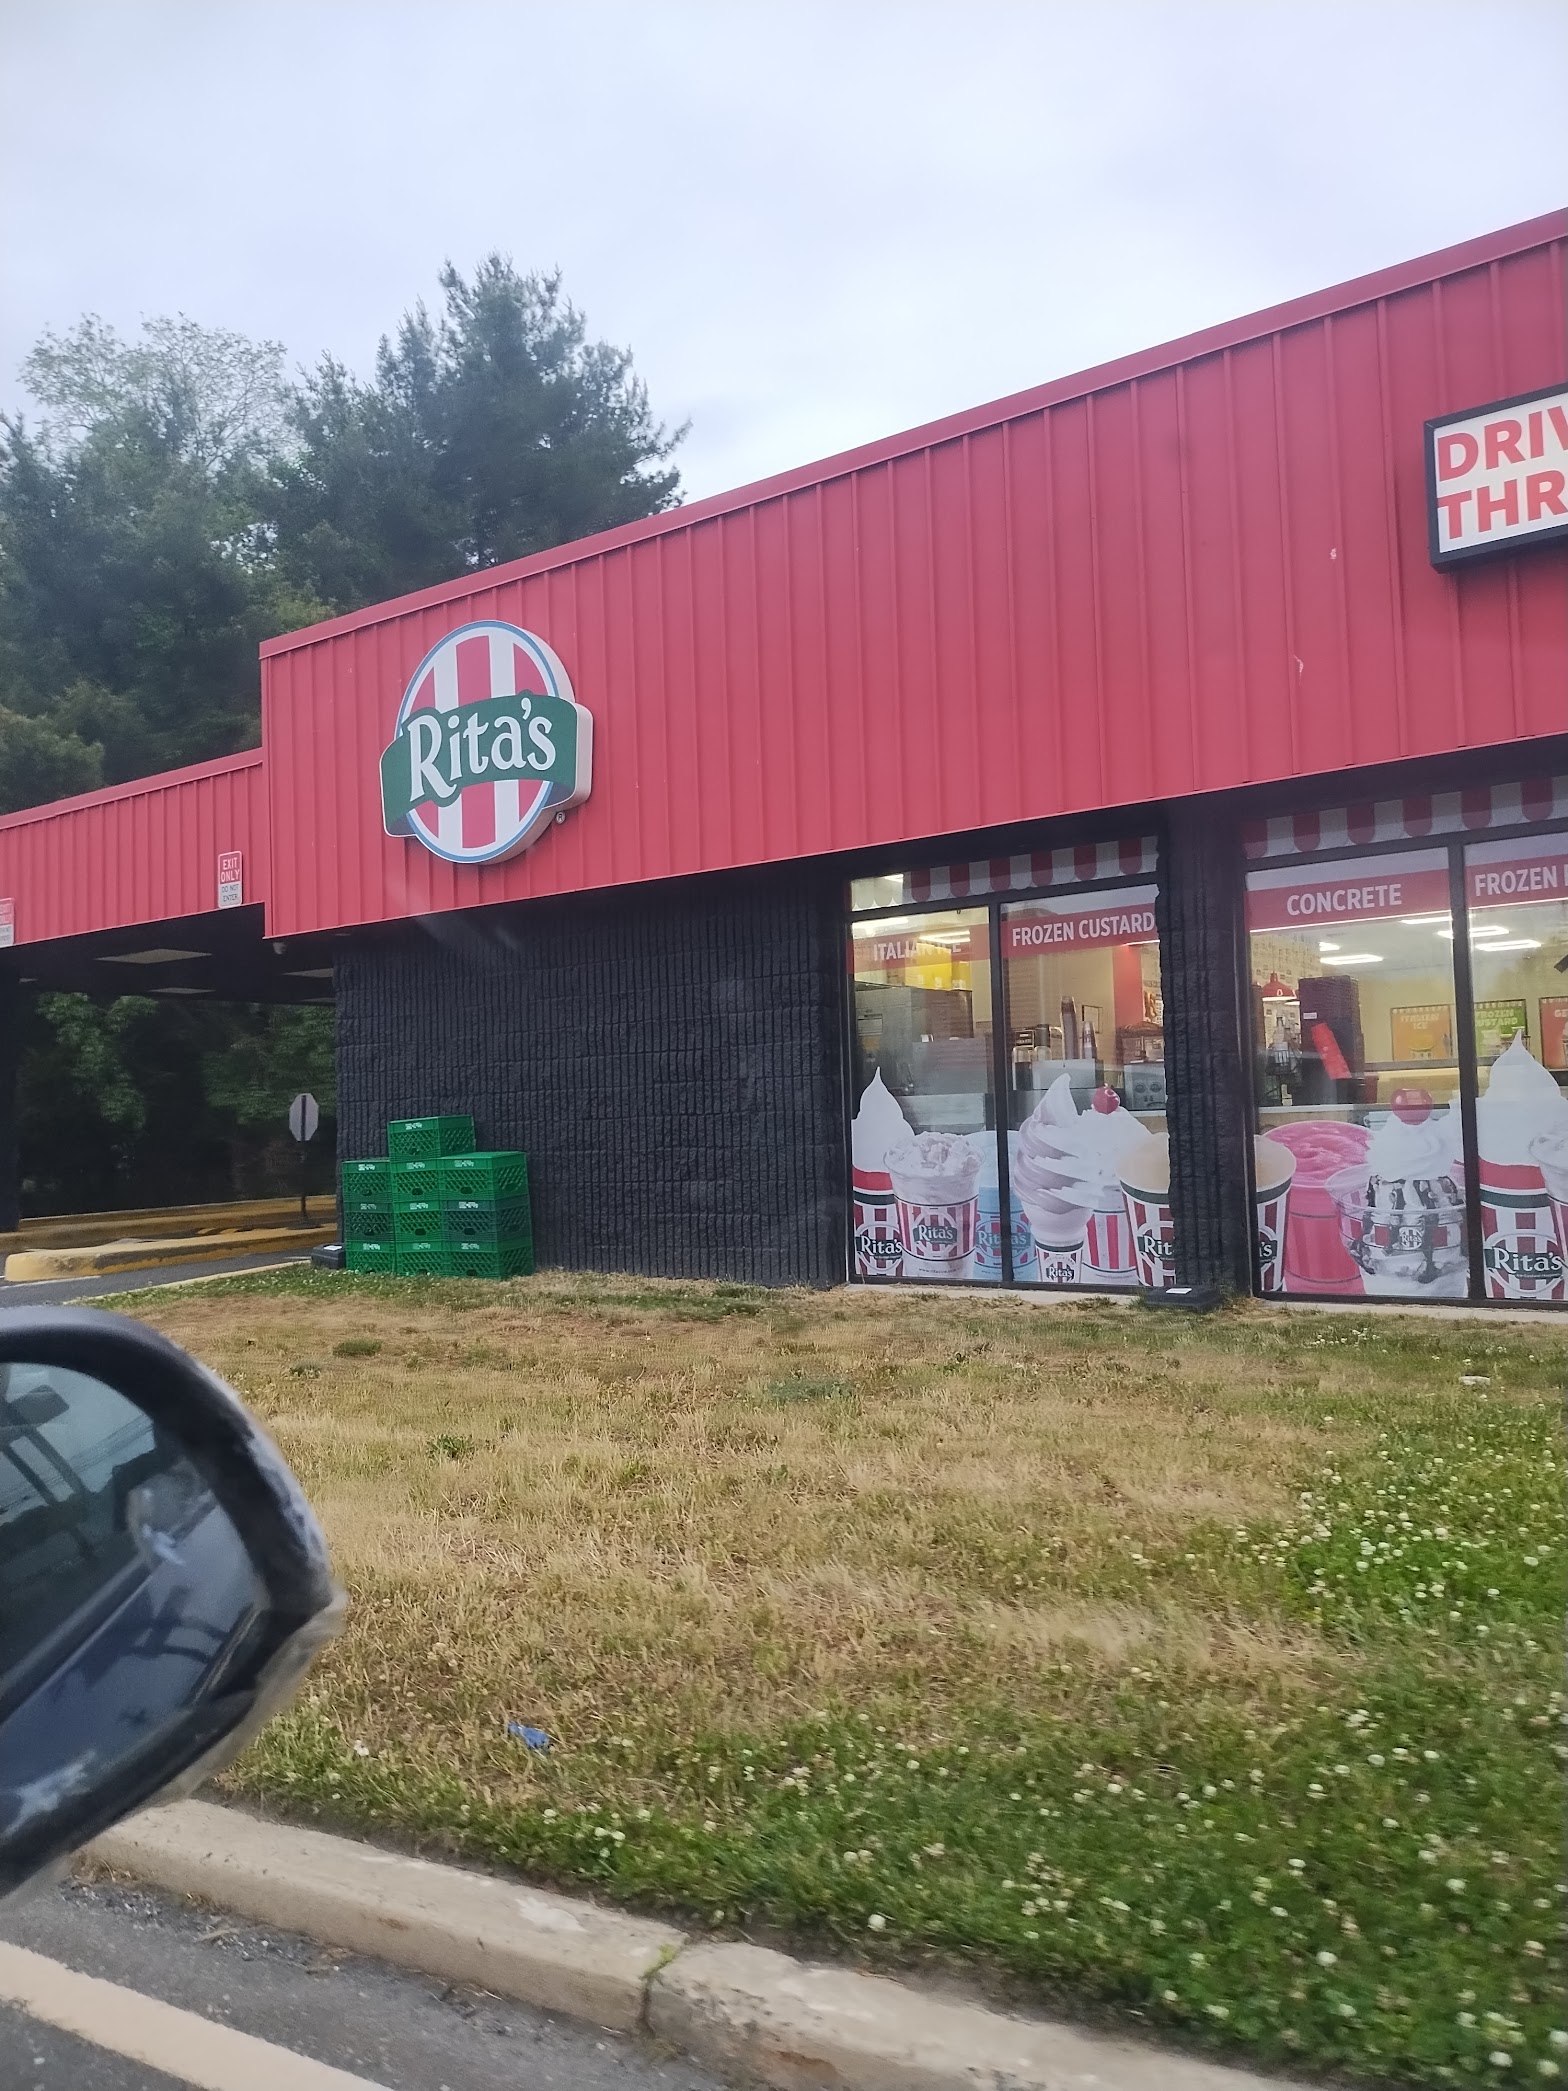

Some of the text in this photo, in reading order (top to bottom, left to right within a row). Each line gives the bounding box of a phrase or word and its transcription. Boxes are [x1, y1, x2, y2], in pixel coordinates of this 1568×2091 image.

[407, 697, 557, 803] Rita's
[222, 857, 238, 870] EXIT
[220, 869, 240, 882] ONLY
[1475, 865, 1558, 897] FROZEN
[1286, 883, 1403, 916] CONCRETE
[1012, 911, 1156, 947] FROZEN CUSTARD
[1476, 1017, 1518, 1027] USTARD
[919, 1224, 954, 1242] Rita's
[1401, 1233, 1422, 1244] Rita's
[860, 1235, 901, 1256] Rita's
[1493, 1247, 1563, 1275] Rita's
[1048, 1266, 1073, 1278] Rita's
